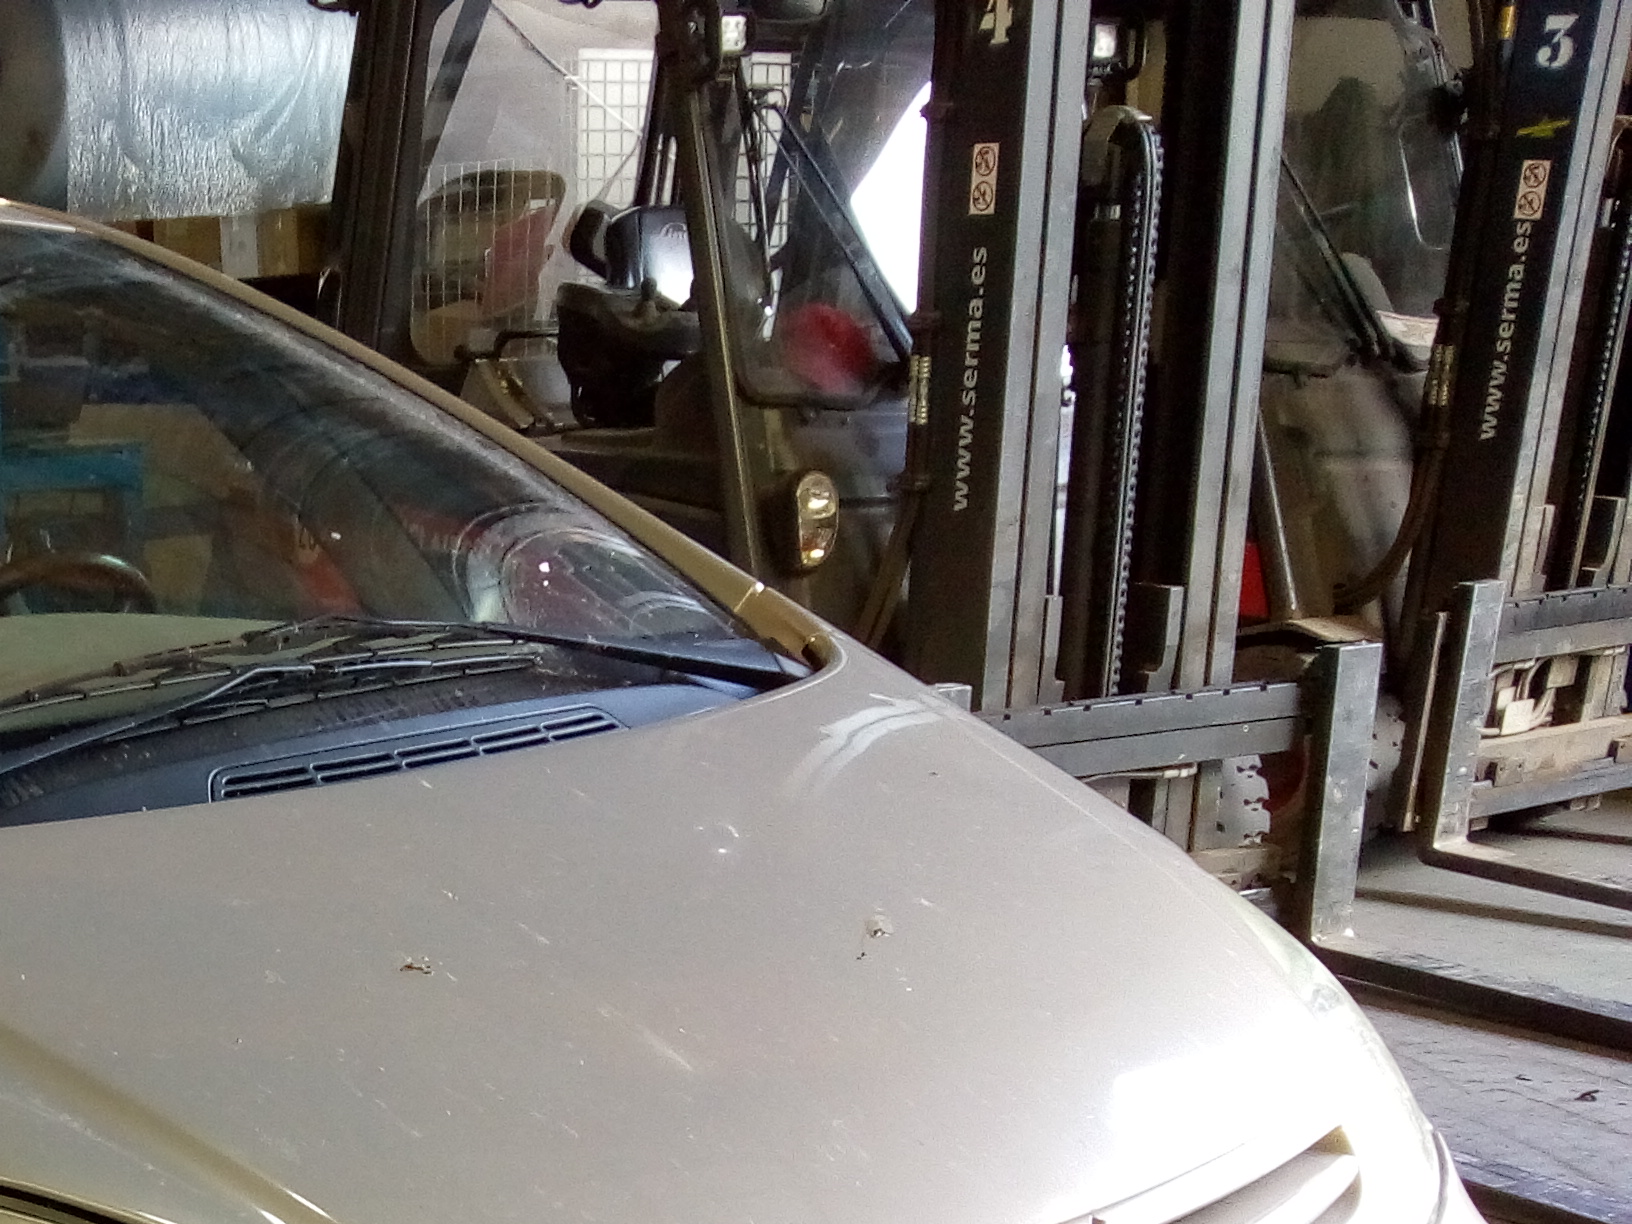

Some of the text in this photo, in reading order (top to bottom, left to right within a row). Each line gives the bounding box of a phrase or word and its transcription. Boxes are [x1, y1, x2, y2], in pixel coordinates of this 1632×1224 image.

[978, 0, 1014, 45] 4
[1536, 14, 1580, 68] 3
[954, 246, 988, 511] www.serma.es
[1479, 219, 1533, 441] www.serma.es
